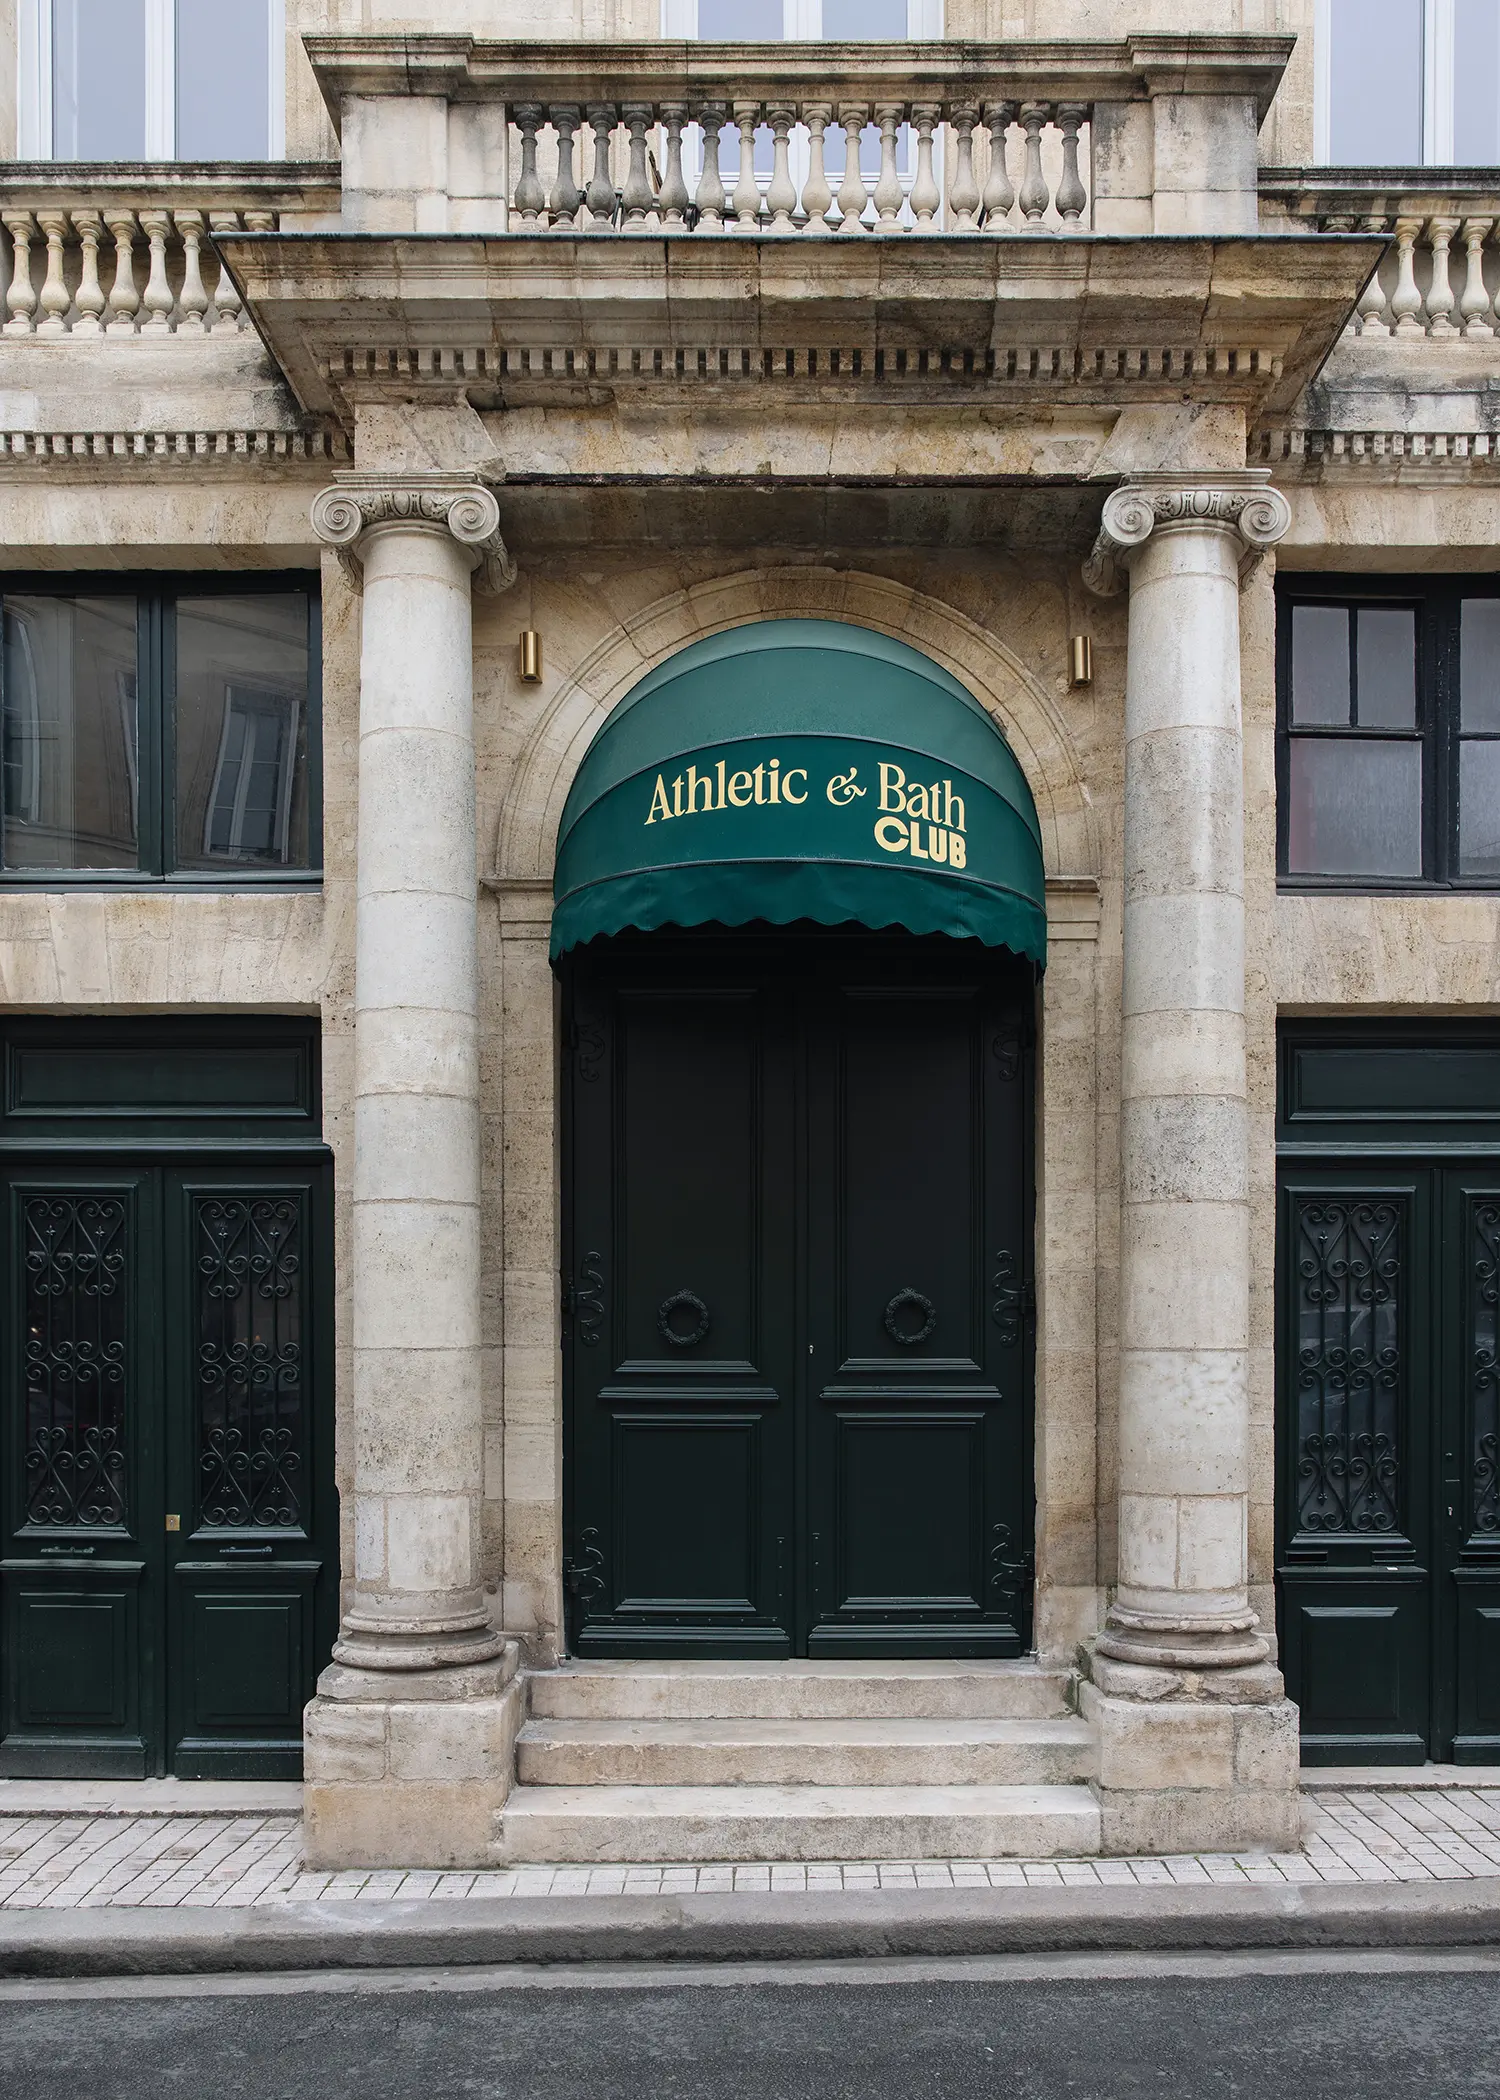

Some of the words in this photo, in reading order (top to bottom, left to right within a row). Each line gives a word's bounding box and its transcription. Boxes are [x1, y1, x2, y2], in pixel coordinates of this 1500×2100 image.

[644, 758, 809, 826] Athletic
[826, 766, 867, 806] &
[877, 761, 967, 833] Bath
[873, 815, 967, 870] CLUB
